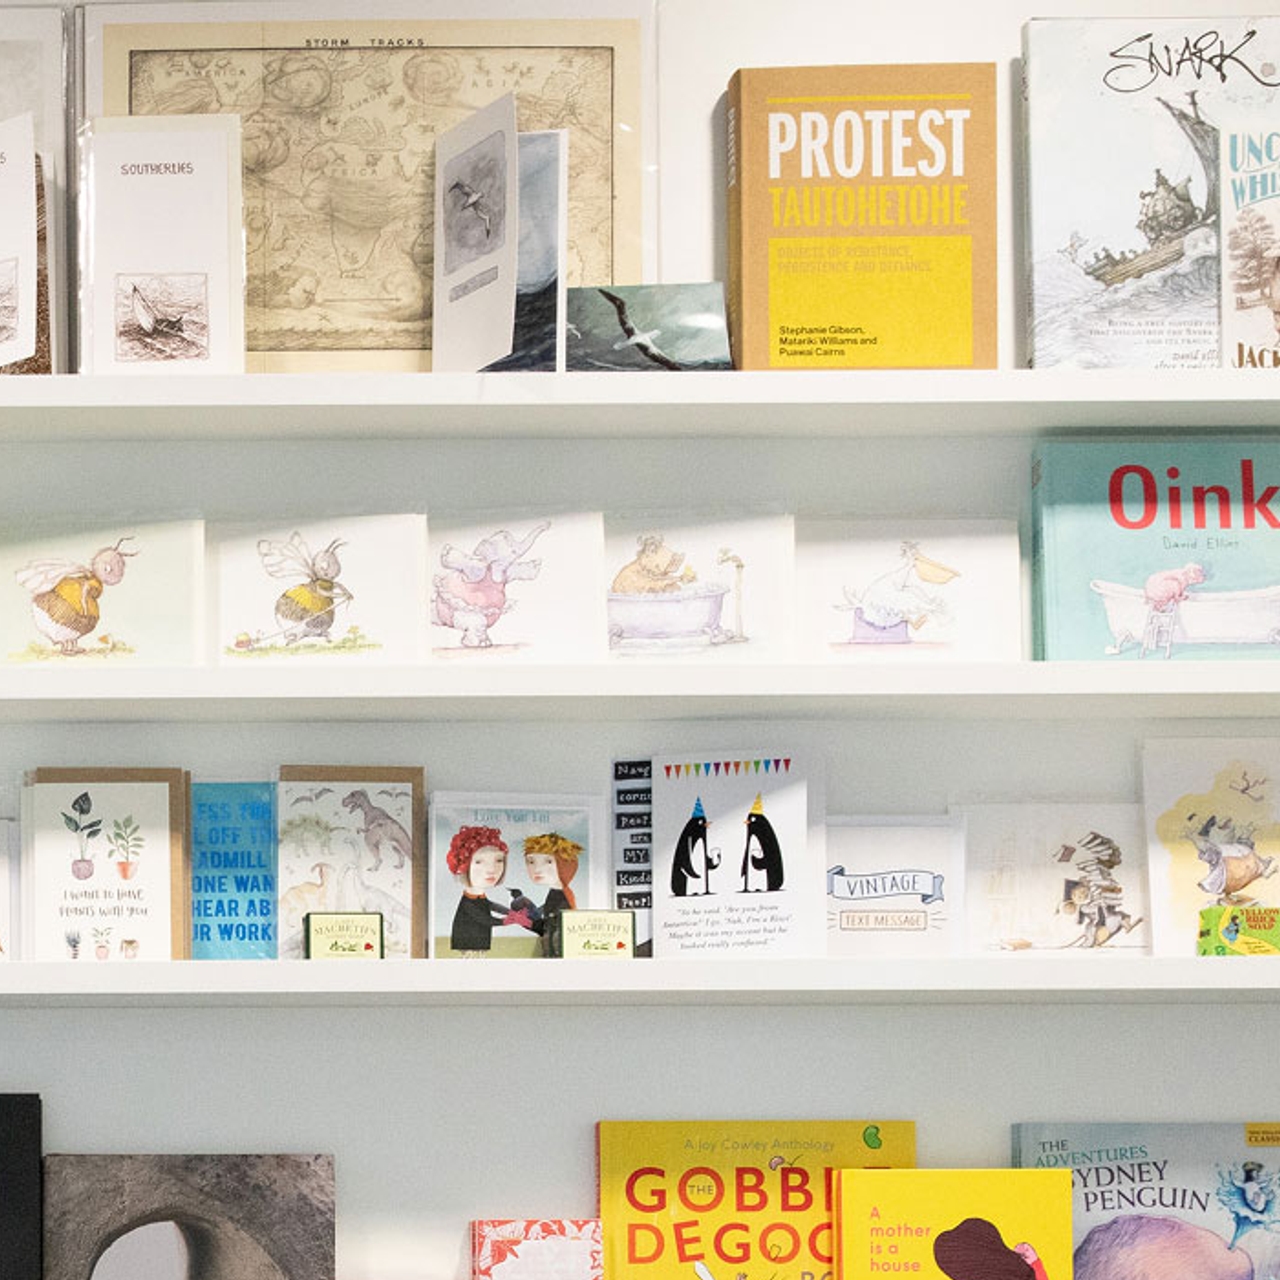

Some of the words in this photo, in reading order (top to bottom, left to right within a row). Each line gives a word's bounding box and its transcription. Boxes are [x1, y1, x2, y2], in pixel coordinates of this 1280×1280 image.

[305, 38, 349, 47] STORM
[370, 38, 424, 46] TRACKS
[1103, 29, 1278, 92] SNARK
[768, 109, 971, 179] PROTEST
[121, 162, 194, 175] SOUTHERLIES
[768, 184, 969, 229] TAUTOHETOHE
[779, 325, 827, 336] Stephanie
[829, 324, 865, 335] Gibson,
[779, 336, 817, 345] Matariki
[820, 335, 857, 345] Williams
[859, 336, 878, 345] and
[1108, 459, 1280, 530] Oink
[625, 850, 646, 861] MY
[846, 874, 920, 896] VINTAGE
[846, 915, 870, 926] TEXT
[874, 914, 921, 926] MESSAGE
[217, 923, 272, 941] WORK
[1039, 1139, 1068, 1153] THE
[1035, 1145, 1148, 1168] ADVENTURES
[688, 1185, 714, 1195] THE
[1083, 1186, 1211, 1212] PENGUIN
[870, 1207, 881, 1218] A
[870, 1224, 931, 1237] mother
[870, 1243, 882, 1254] is
[888, 1244, 898, 1254] a
[870, 1258, 921, 1272] house
